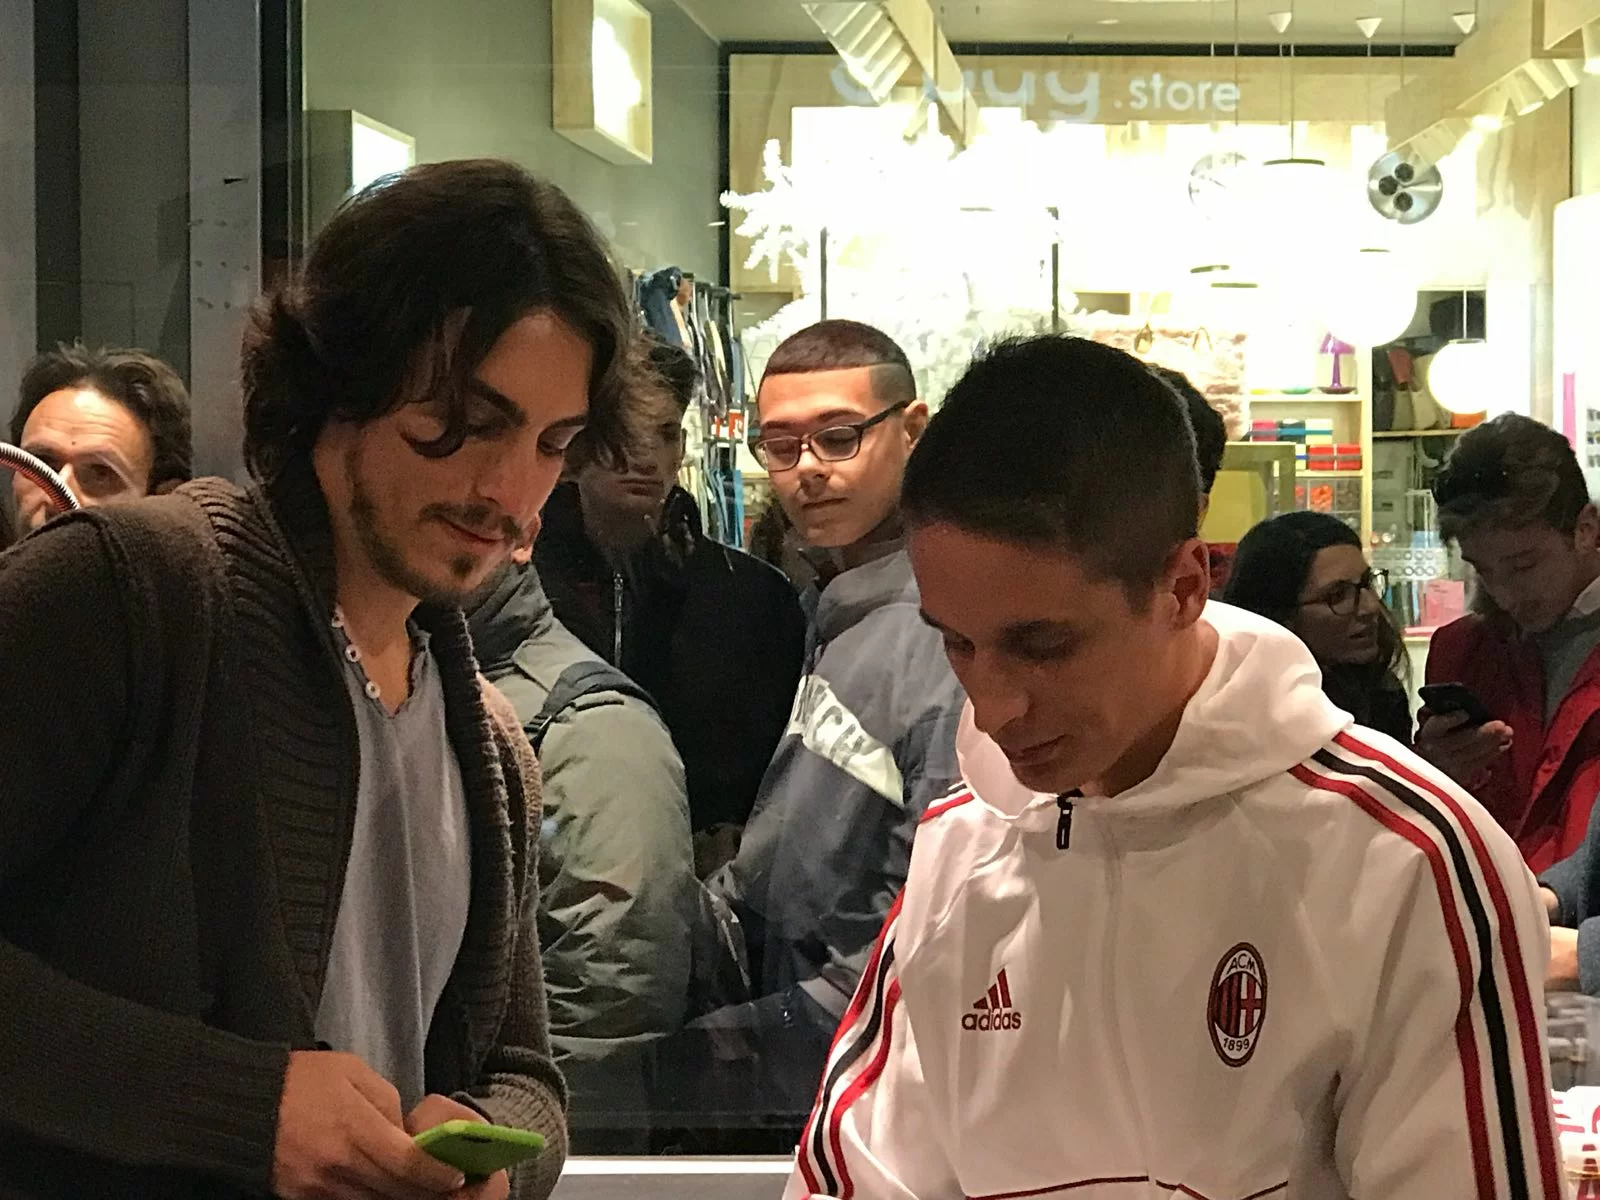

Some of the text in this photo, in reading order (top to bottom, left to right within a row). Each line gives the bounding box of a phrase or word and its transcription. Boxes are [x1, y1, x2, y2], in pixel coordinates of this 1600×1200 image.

[1227, 953, 1256, 975] ACM
[961, 1008, 1021, 1031] adidas
[1223, 1038, 1250, 1052] 1899
